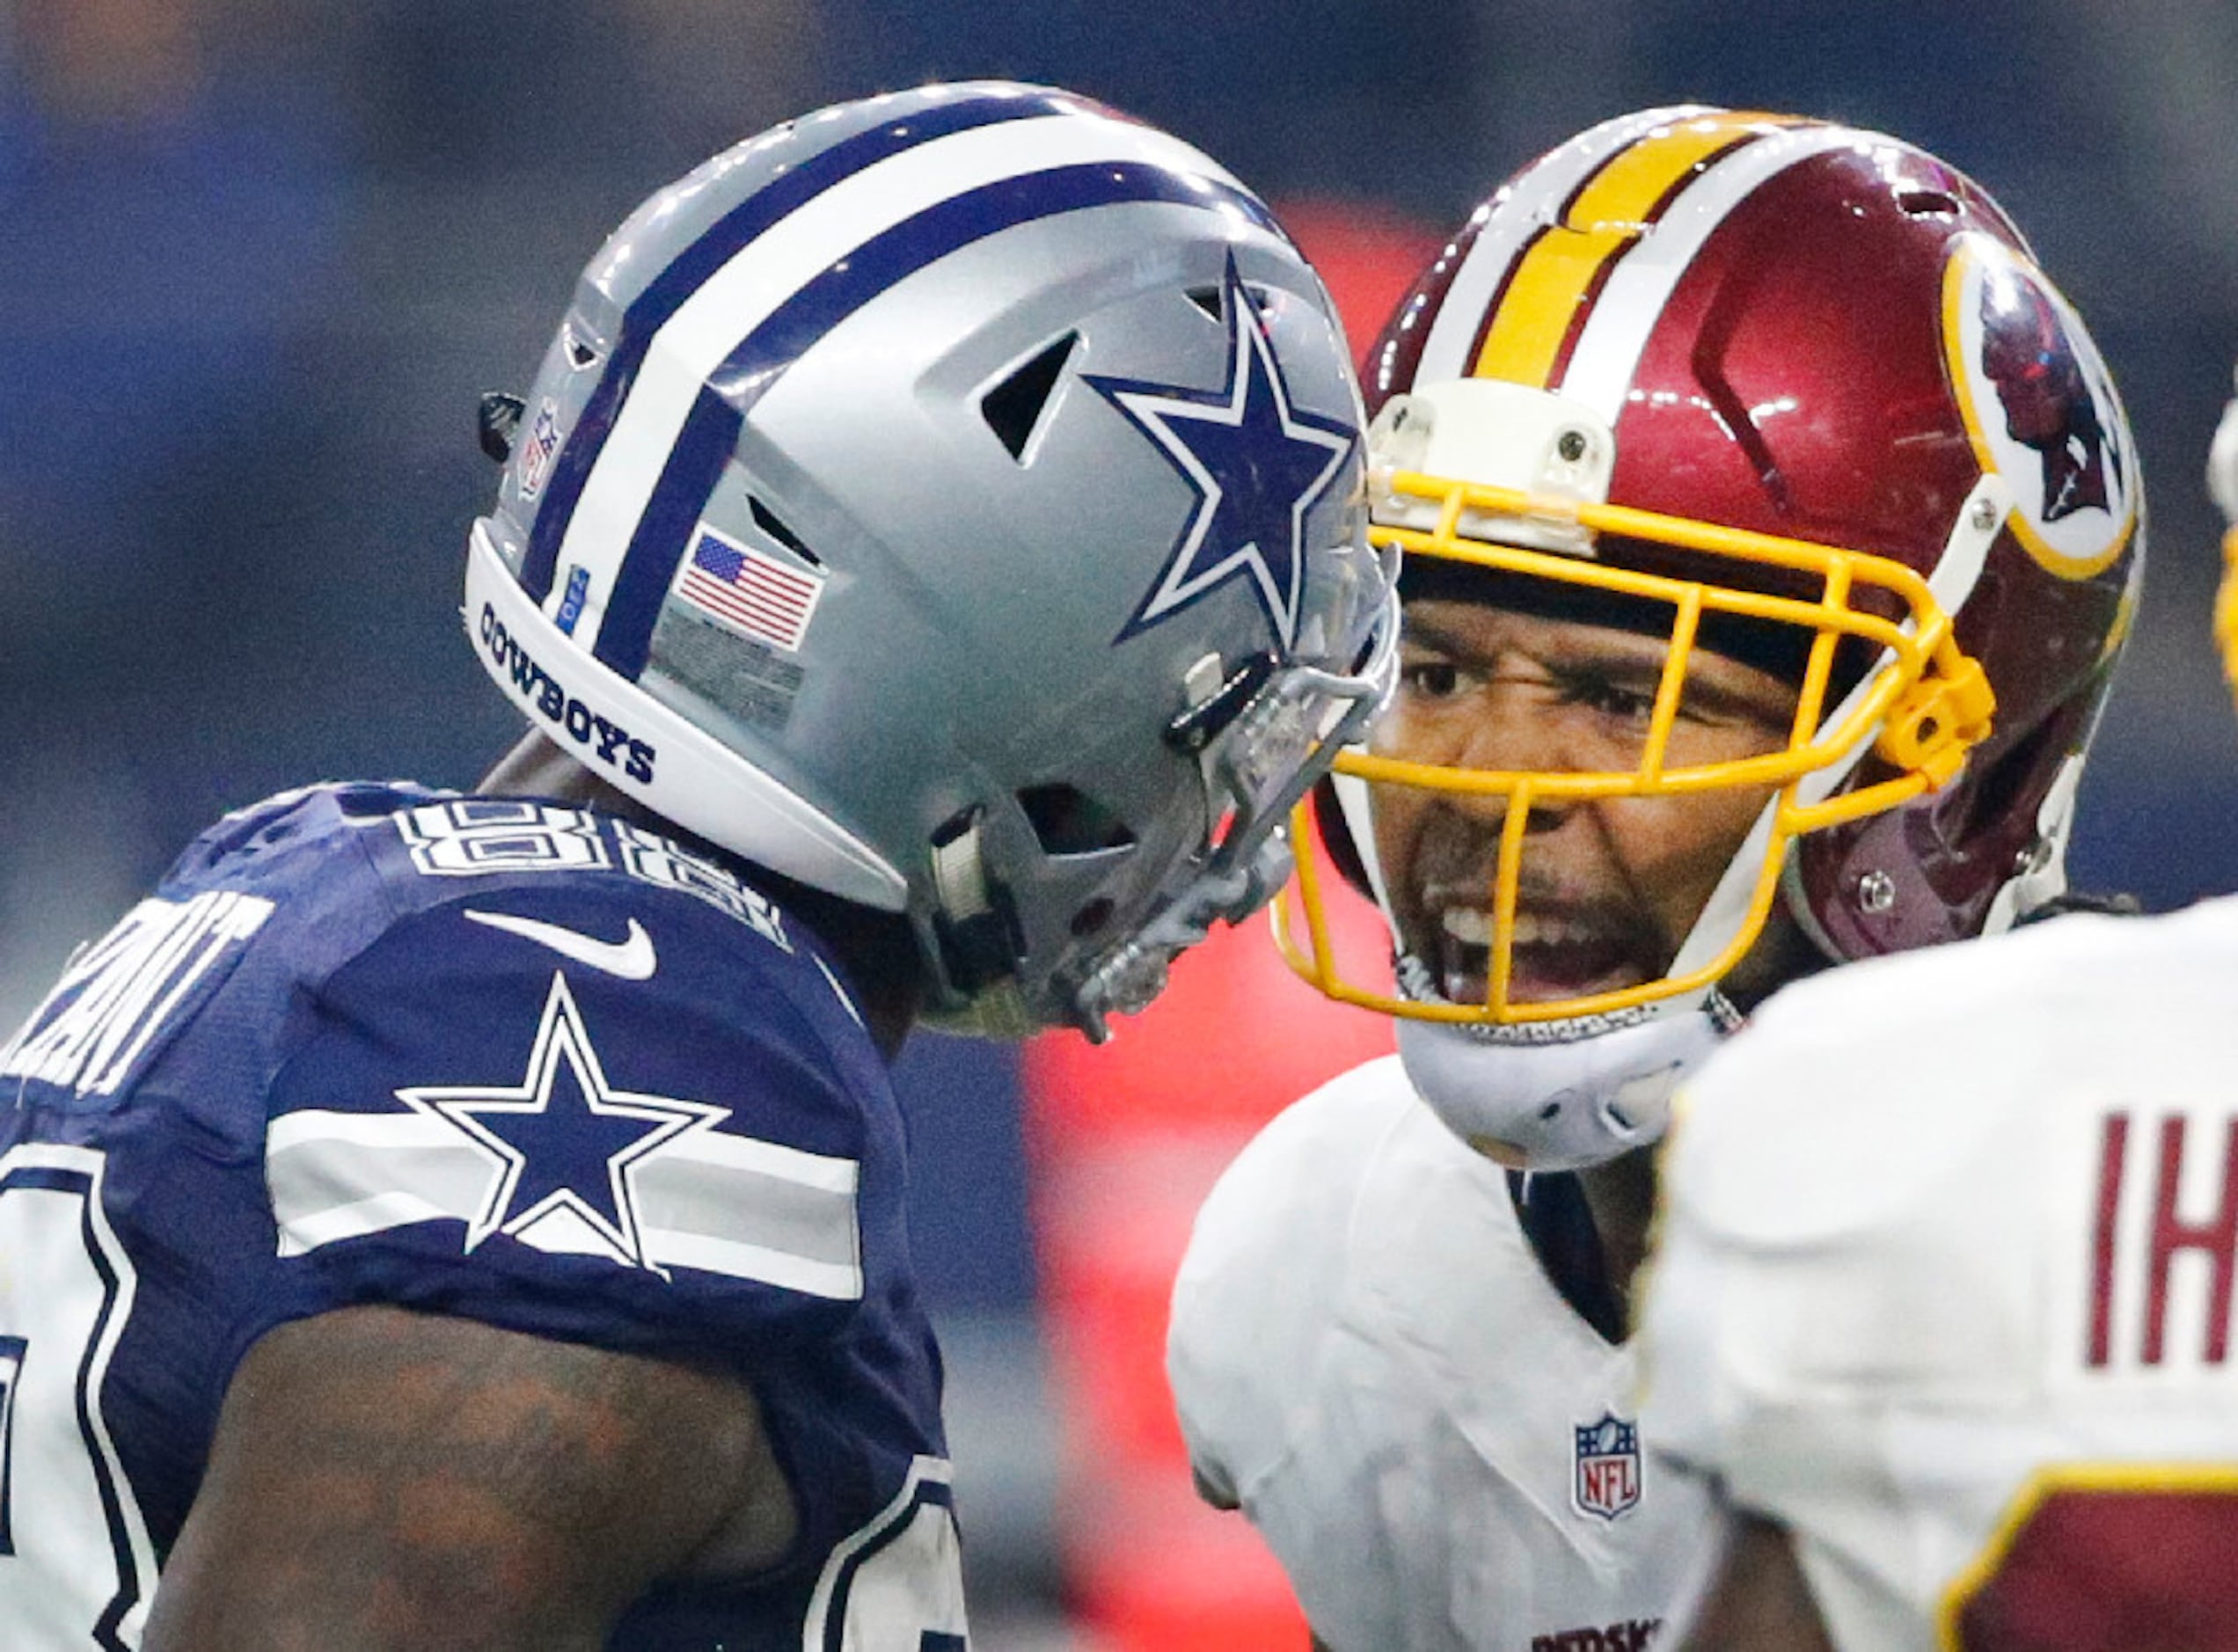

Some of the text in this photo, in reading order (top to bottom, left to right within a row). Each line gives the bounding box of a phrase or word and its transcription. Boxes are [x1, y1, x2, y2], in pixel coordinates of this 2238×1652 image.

[481, 602, 656, 784] COWBOYS
[2086, 1113, 2238, 1366] IH
[1584, 1459, 1635, 1509] NFL
